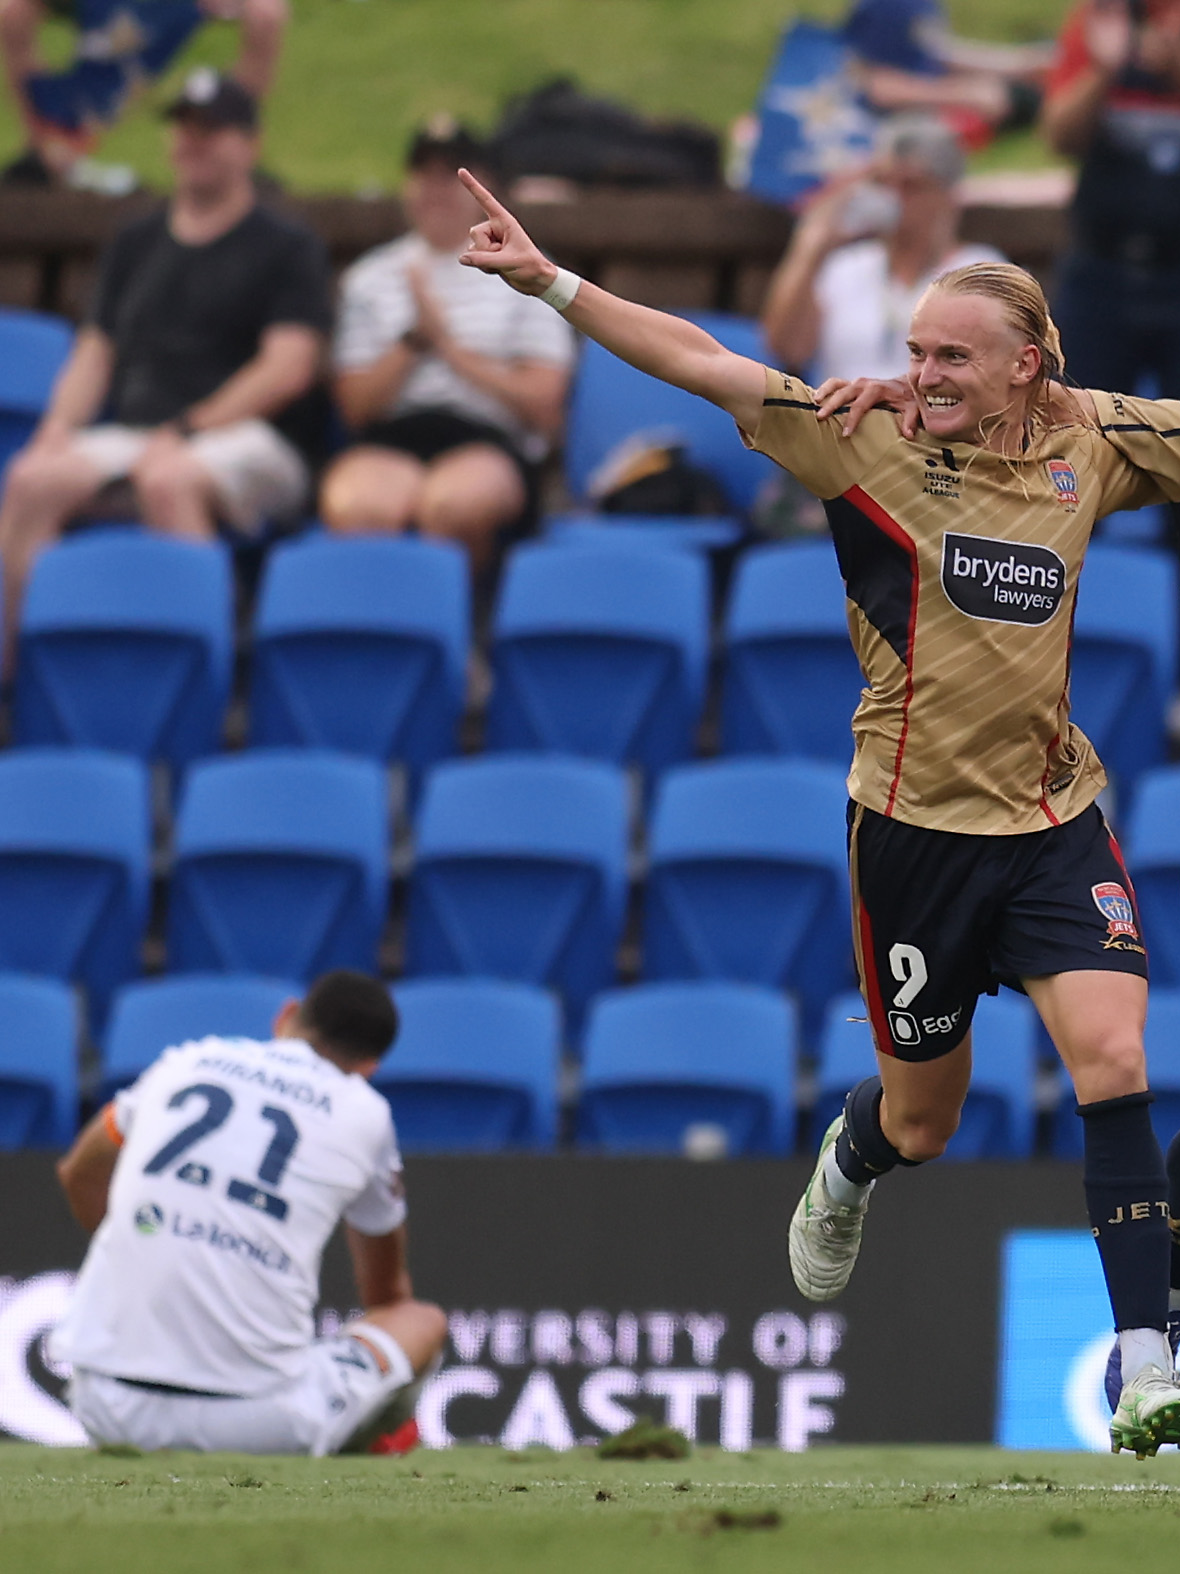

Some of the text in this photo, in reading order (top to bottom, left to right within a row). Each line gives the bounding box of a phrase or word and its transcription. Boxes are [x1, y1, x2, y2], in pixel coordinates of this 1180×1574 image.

[924, 471, 960, 485] ISUZU
[952, 548, 1060, 596] brydens
[993, 584, 1054, 611] lawyers
[1114, 922, 1134, 934] JETS
[888, 942, 928, 1009] 9
[142, 1081, 302, 1222] 21
[1107, 1200, 1171, 1225] JET
[752, 1310, 848, 1369] OF
